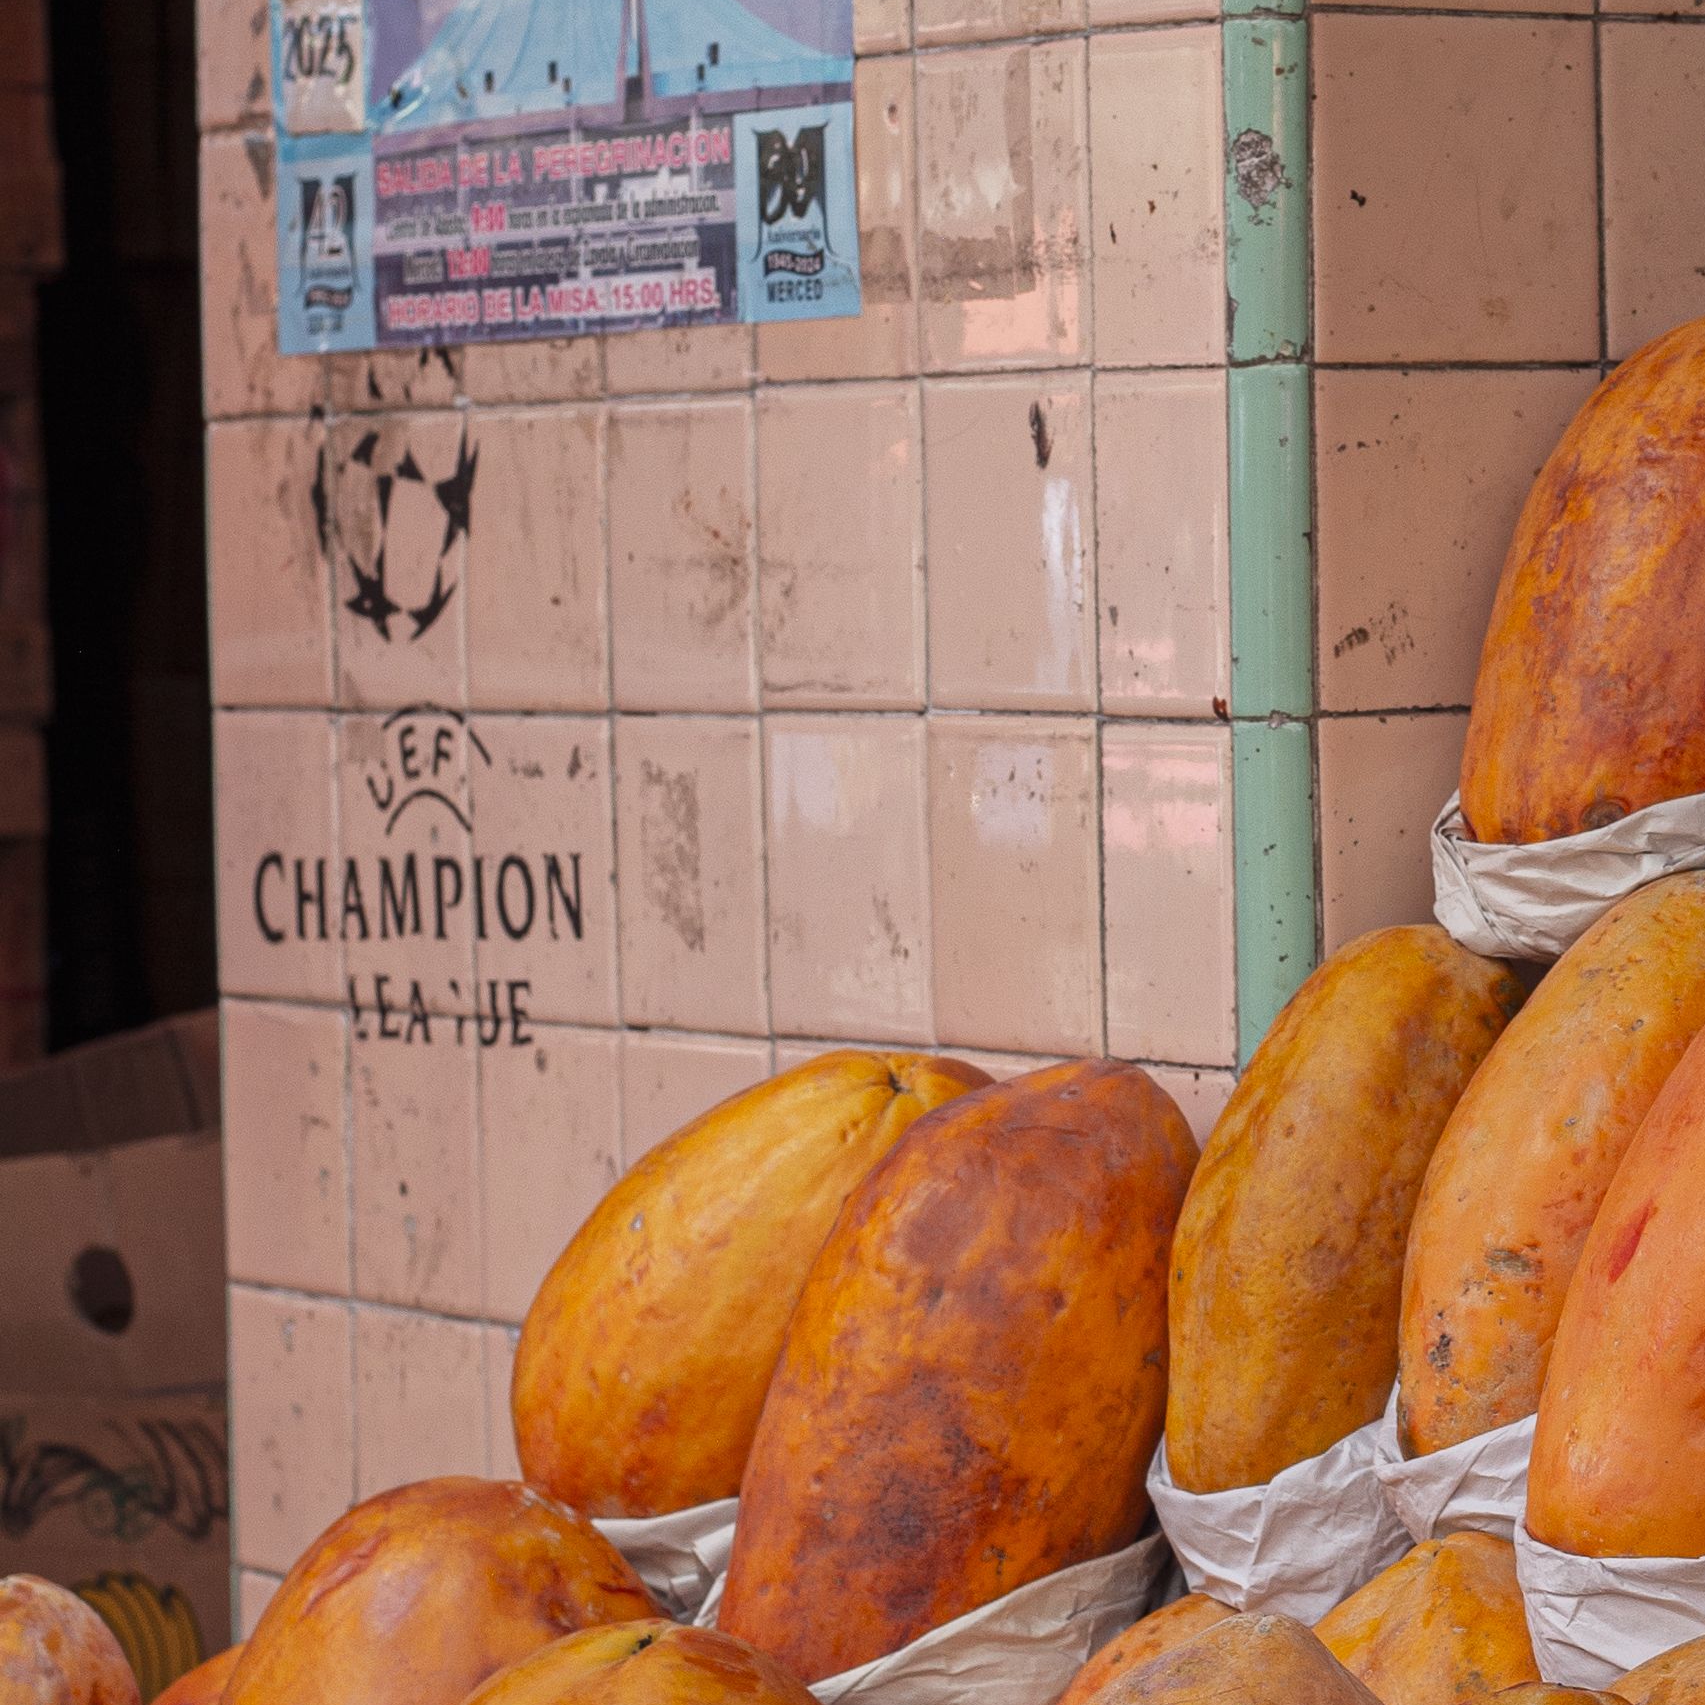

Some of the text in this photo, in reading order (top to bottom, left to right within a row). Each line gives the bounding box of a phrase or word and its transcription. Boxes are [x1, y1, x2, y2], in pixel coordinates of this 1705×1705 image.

[284, 15, 359, 86] 2025
[375, 156, 451, 197] SALIDA
[458, 152, 490, 189] DE
[495, 150, 523, 186] LA
[386, 291, 480, 329] HORARIO
[482, 288, 513, 323] DE
[515, 286, 547, 319] LA
[766, 277, 824, 304] MERCED
[253, 850, 584, 945] CHAMPION
